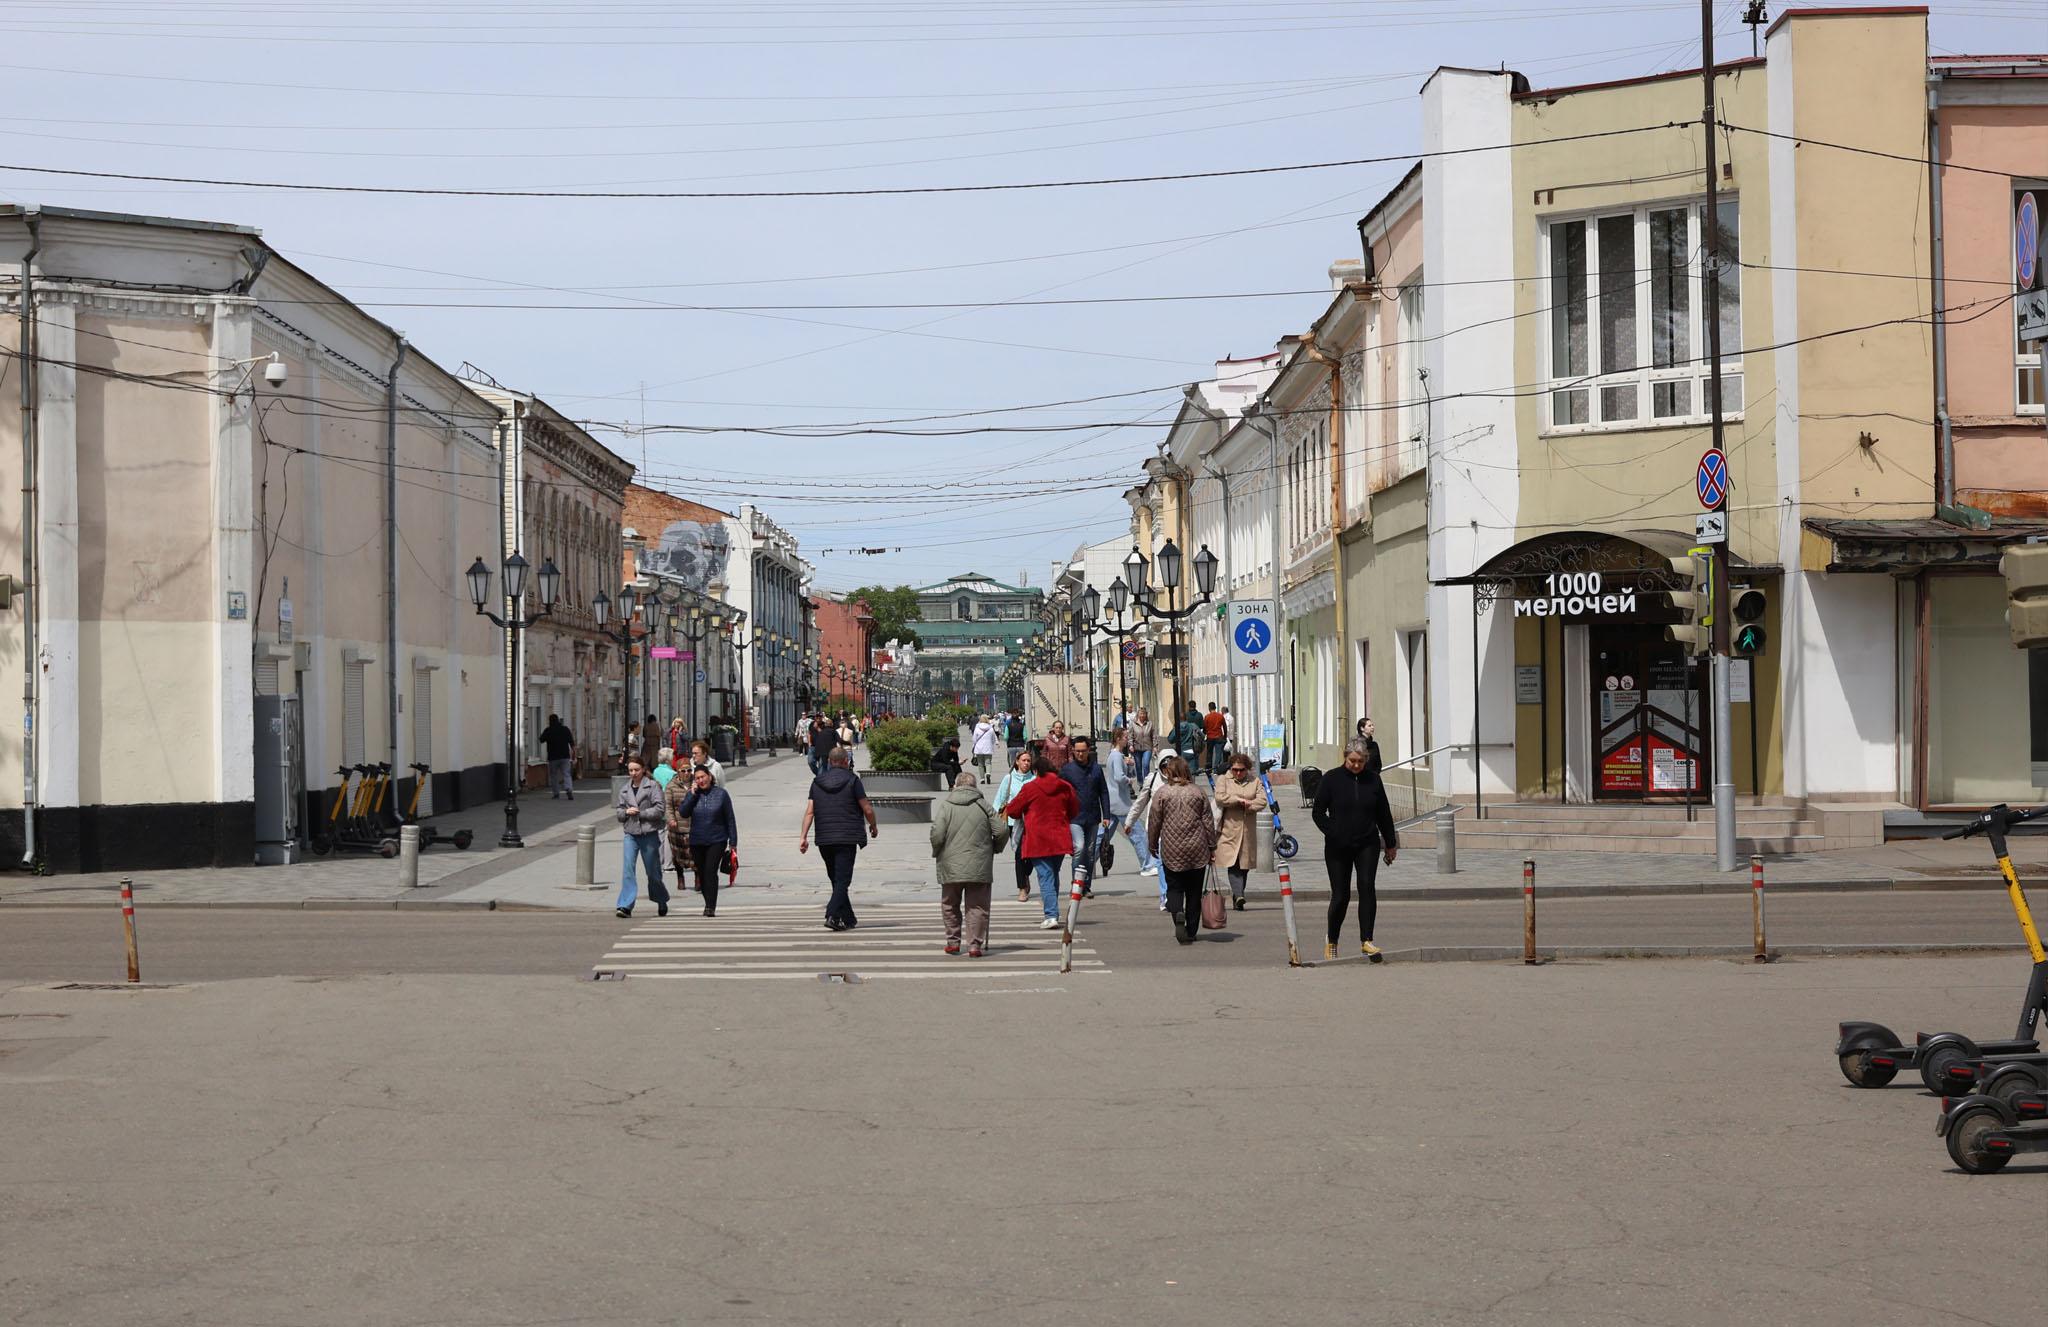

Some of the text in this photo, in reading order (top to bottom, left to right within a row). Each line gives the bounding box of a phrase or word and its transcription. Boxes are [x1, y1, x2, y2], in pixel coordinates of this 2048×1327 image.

[1546, 572, 1601, 597] 1000
[1237, 604, 1269, 614] ЗОНА
[1514, 587, 1636, 617] мелочей
